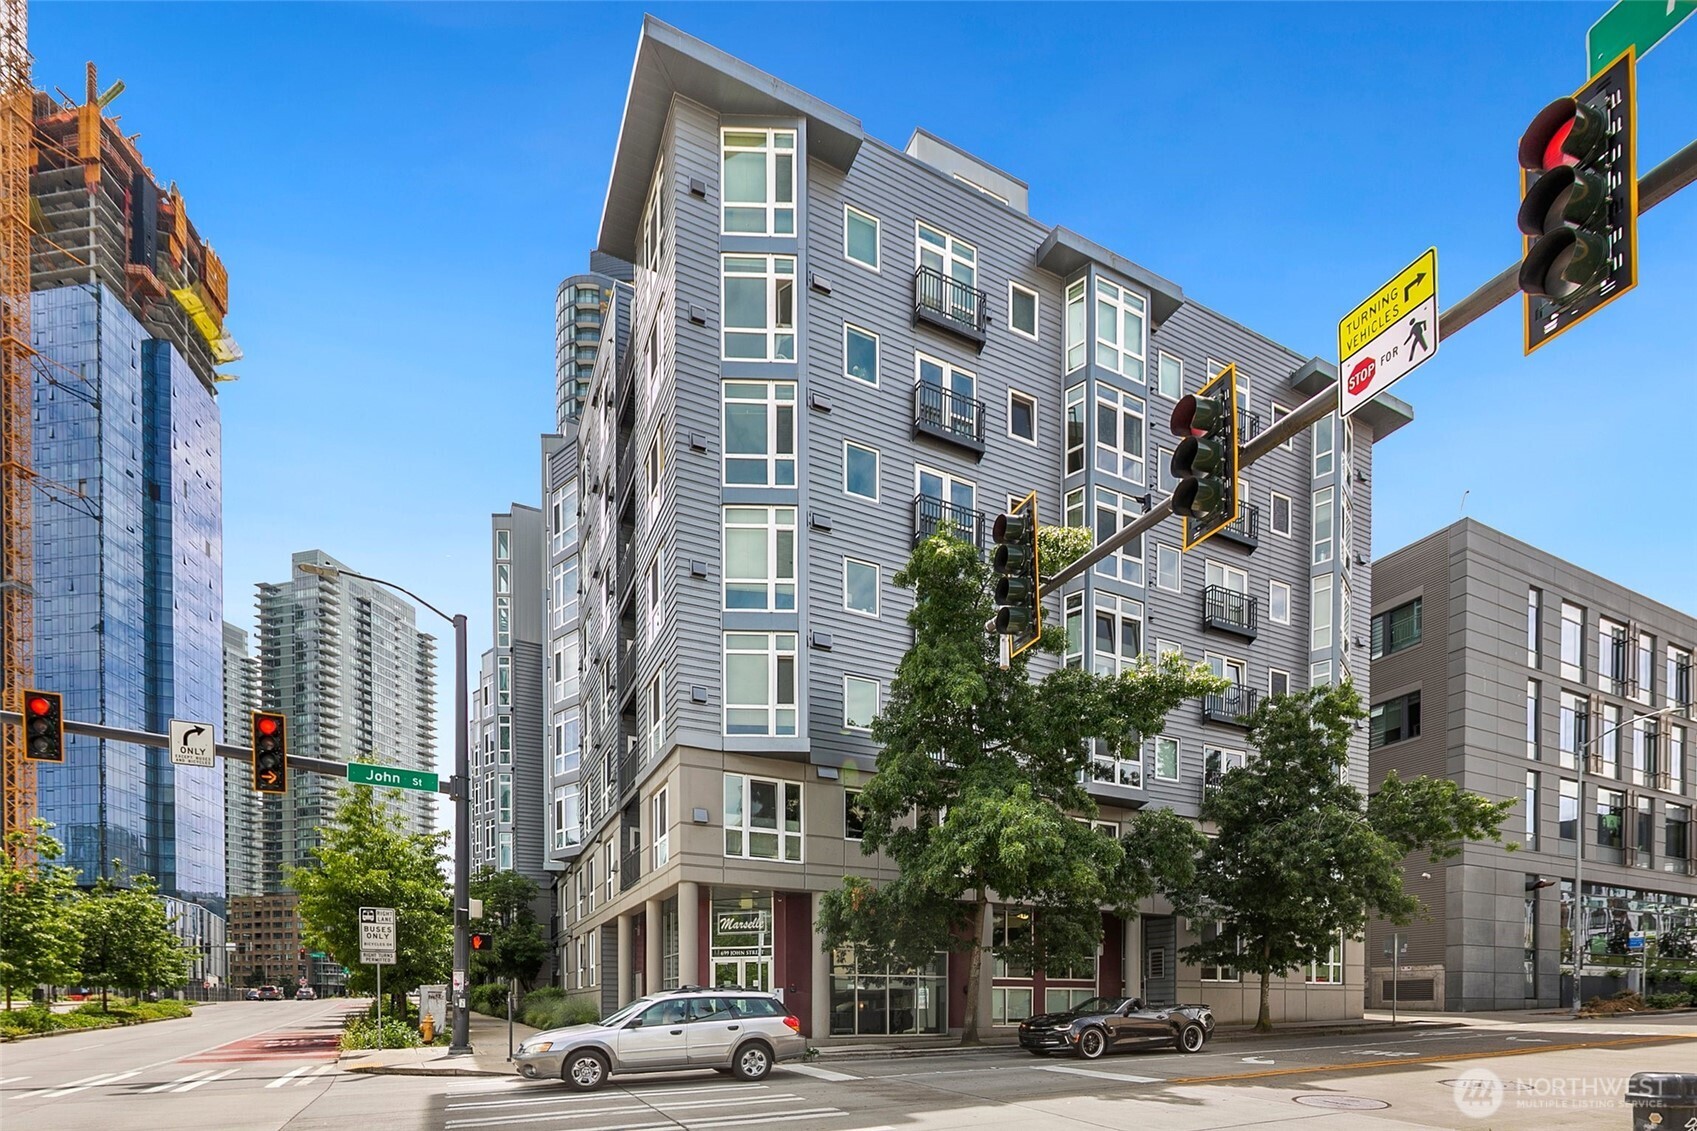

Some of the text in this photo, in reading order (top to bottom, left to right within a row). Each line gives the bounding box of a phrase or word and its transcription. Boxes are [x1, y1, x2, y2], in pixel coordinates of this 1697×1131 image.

[1346, 287, 1399, 335] TURNING
[1346, 304, 1400, 352] VEHICLES
[1348, 346, 1399, 390] STOP FOR
[180, 746, 206, 755] ONLY
[366, 769, 422, 787] John St
